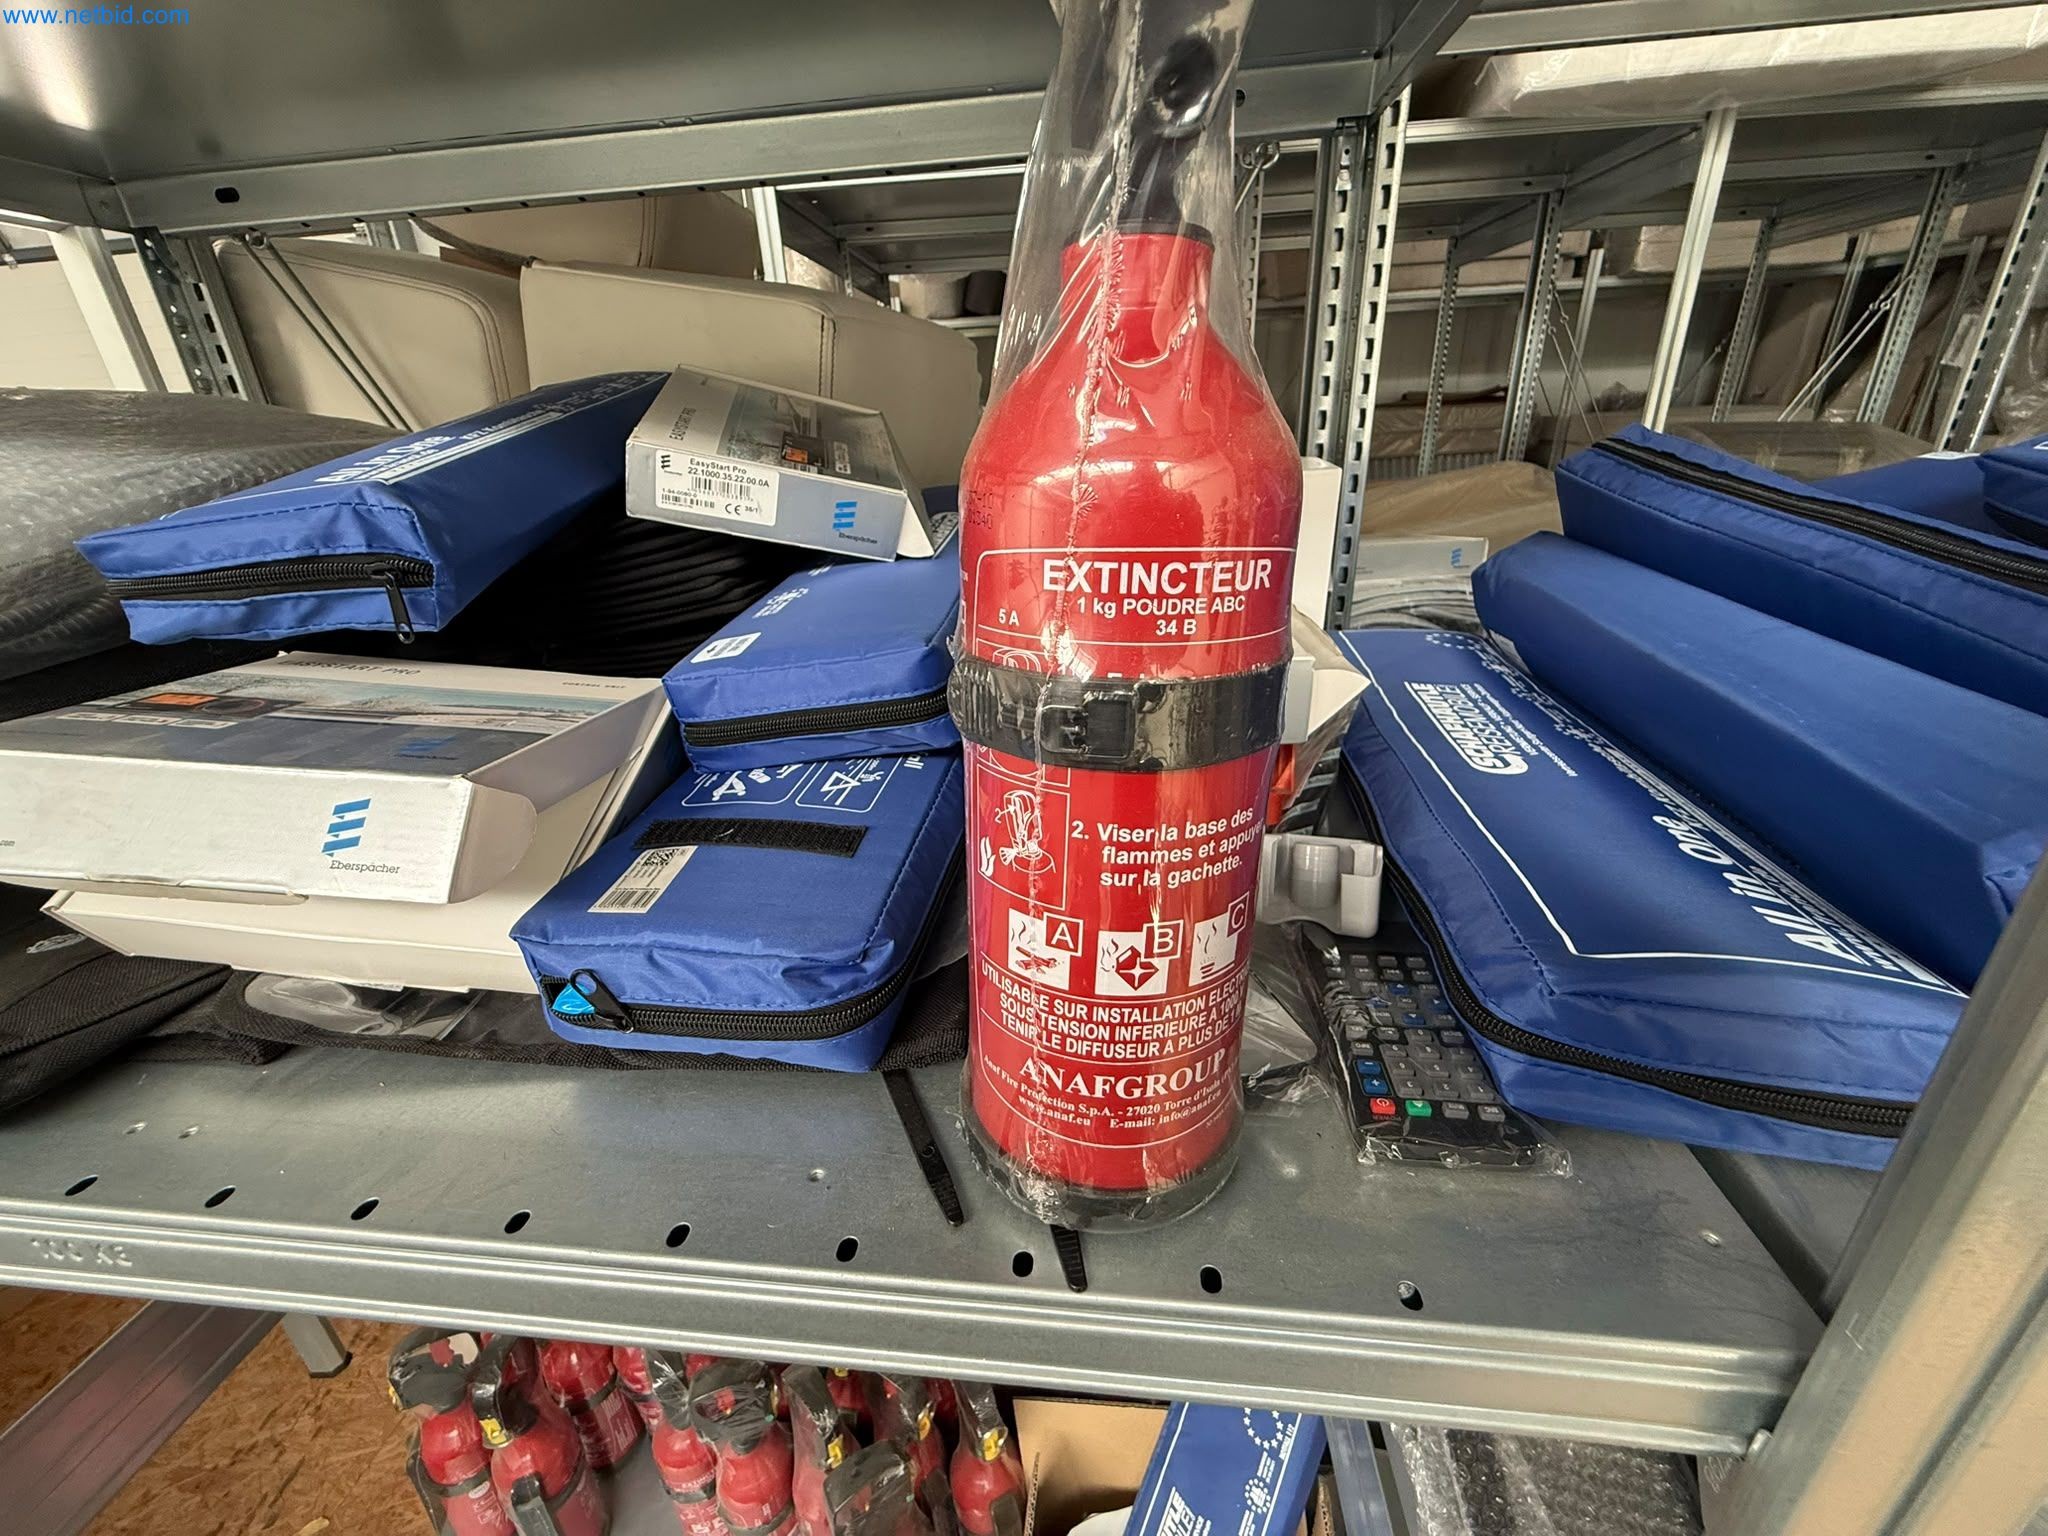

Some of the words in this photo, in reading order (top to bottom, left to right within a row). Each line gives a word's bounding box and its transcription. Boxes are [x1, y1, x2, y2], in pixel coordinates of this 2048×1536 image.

[687, 466, 770, 488] 22.1000.35.22.00.0A
[689, 457, 730, 472] EasyStart
[732, 465, 748, 475] Pro
[1042, 558, 1273, 596] EXTINCTEUR
[998, 607, 1007, 624] 5
[1009, 609, 1020, 627] A
[1076, 597, 1087, 615] 1
[1092, 598, 1118, 619] kg
[1122, 598, 1207, 617] POUDRE
[1211, 596, 1246, 614] ABC
[1154, 619, 1178, 636] 34
[1183, 618, 1198, 635] B
[1071, 820, 1090, 840] 2.
[1097, 822, 1155, 842] Viser
[1160, 823, 1178, 842] la
[1185, 817, 1227, 838] base
[1231, 807, 1254, 828] des
[1652, 815, 1734, 865] One
[1100, 871, 1137, 887] sur
[1142, 868, 1161, 887] la
[1167, 853, 1244, 889] gachette.
[1101, 845, 1193, 865] flammes
[1198, 843, 1217, 857] et
[1231, 903, 1246, 930] C
[1050, 923, 1075, 949] A
[1156, 927, 1175, 953] B
[1751, 905, 1866, 964] All
[981, 963, 1050, 1012] UTILISABLE
[1053, 999, 1089, 1020] SUR
[1092, 994, 1207, 1025] INSTALLATION
[1000, 993, 1034, 1021] SOUS
[1041, 1014, 1111, 1041] TENSION
[1114, 1011, 1208, 1042] INFERIEURE
[1208, 1006, 1217, 1024] A
[1000, 1010, 1037, 1039] TENIR
[1042, 1033, 1062, 1050] LE
[1065, 1037, 1161, 1059] DIFFUSEUR
[1163, 1040, 1174, 1056] A
[1178, 1025, 1213, 1052] PLUS
[1215, 1014, 1230, 1036] DE
[983, 1054, 1001, 1075] Anaf
[1001, 1070, 1019, 1089] Fire
[1078, 1103, 1115, 1117] S.p.A.
[1126, 1103, 1161, 1117] 27020
[1163, 1095, 1192, 1111] Torre
[1019, 1047, 1226, 1100] ANAFGROUP
[1018, 1094, 1092, 1127] www.anaf.eu
[1109, 1116, 1156, 1129] E-mail:
[1159, 1088, 1222, 1125] info@anaf.eu
